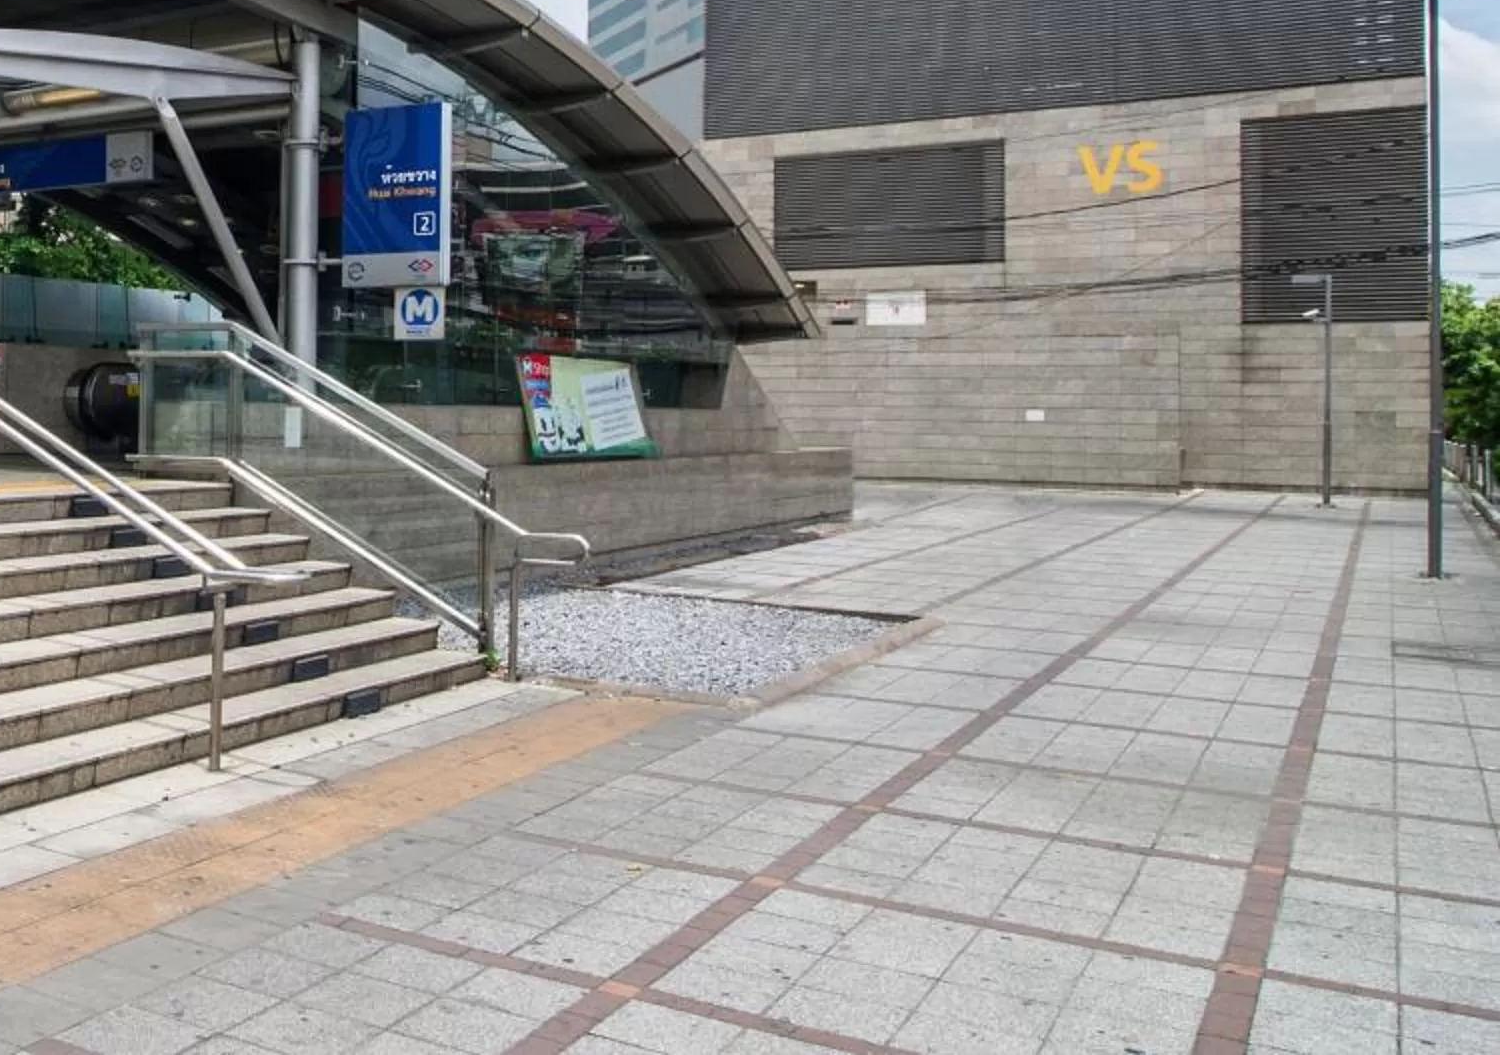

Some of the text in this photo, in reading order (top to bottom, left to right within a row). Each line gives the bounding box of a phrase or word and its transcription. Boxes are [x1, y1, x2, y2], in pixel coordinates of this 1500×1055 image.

[1076, 140, 1164, 194] VS
[420, 216, 430, 232] 2
[405, 295, 434, 323] M
